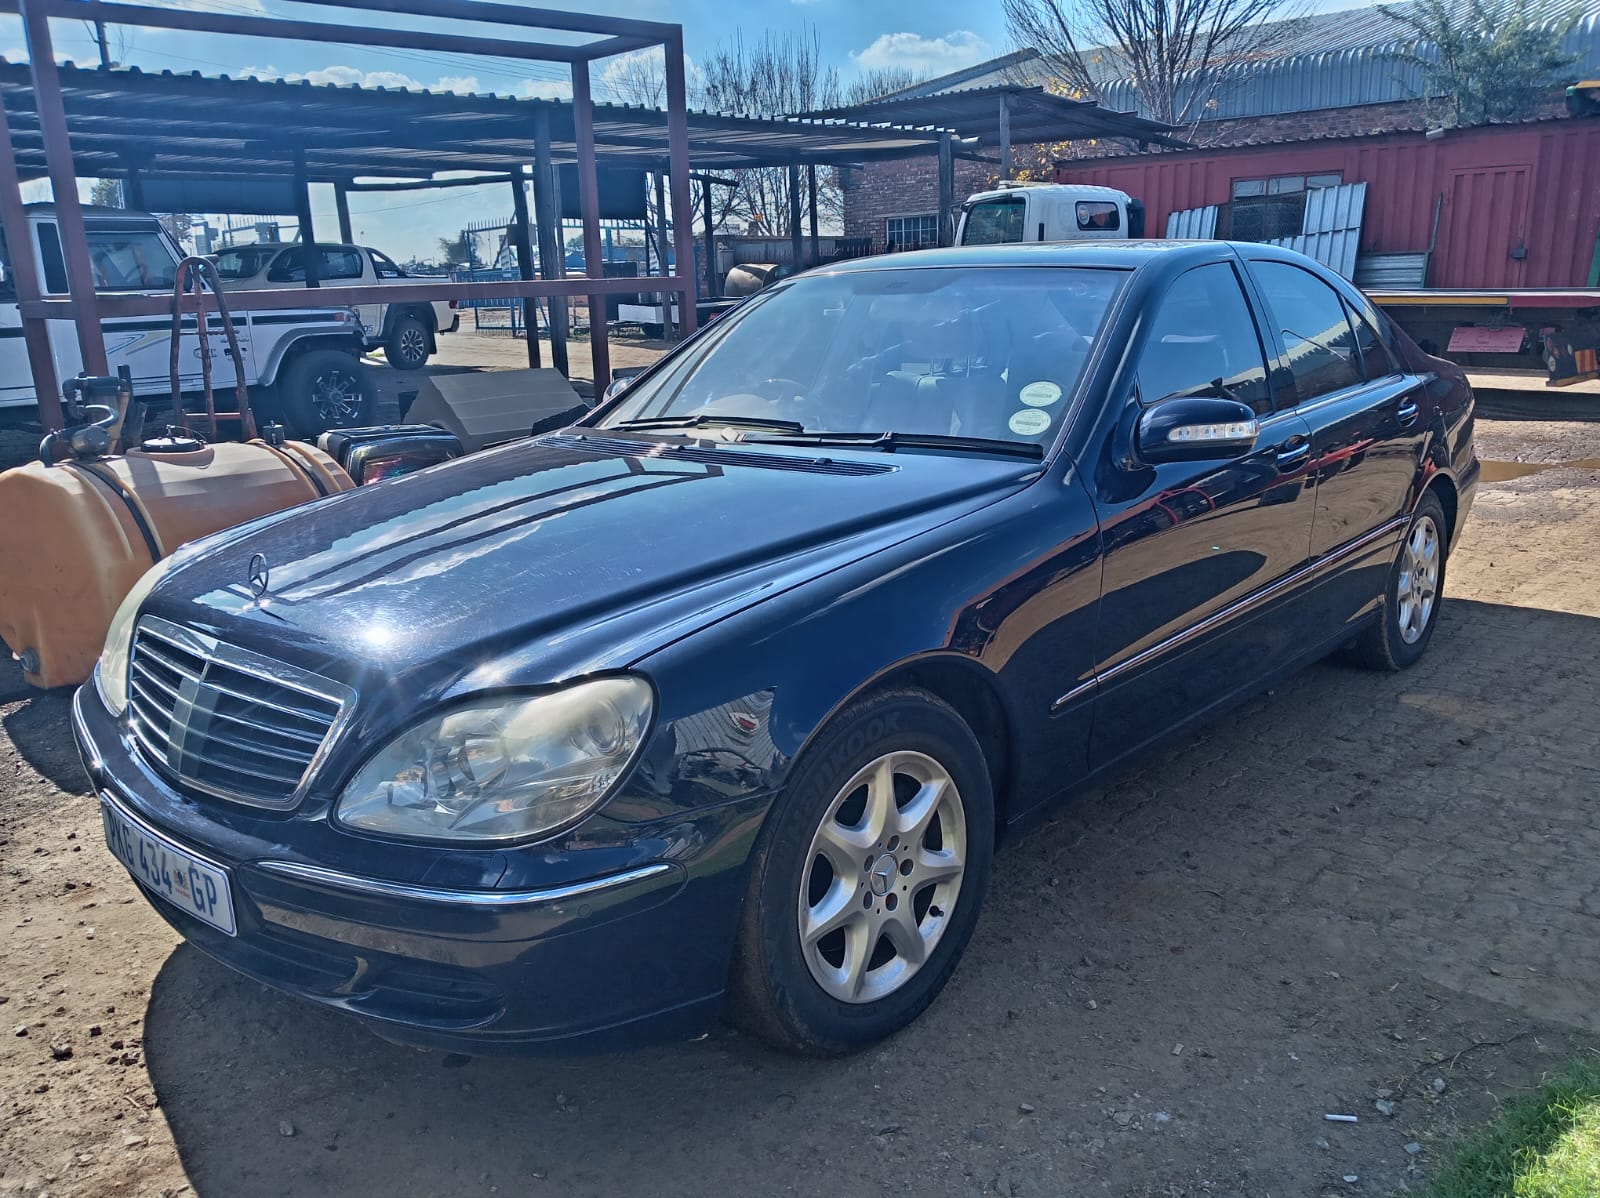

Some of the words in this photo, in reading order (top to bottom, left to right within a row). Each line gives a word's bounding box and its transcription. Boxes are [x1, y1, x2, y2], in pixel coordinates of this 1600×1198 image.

[107, 807, 135, 867] PKG
[139, 838, 173, 894] 434
[188, 865, 217, 917] GP
